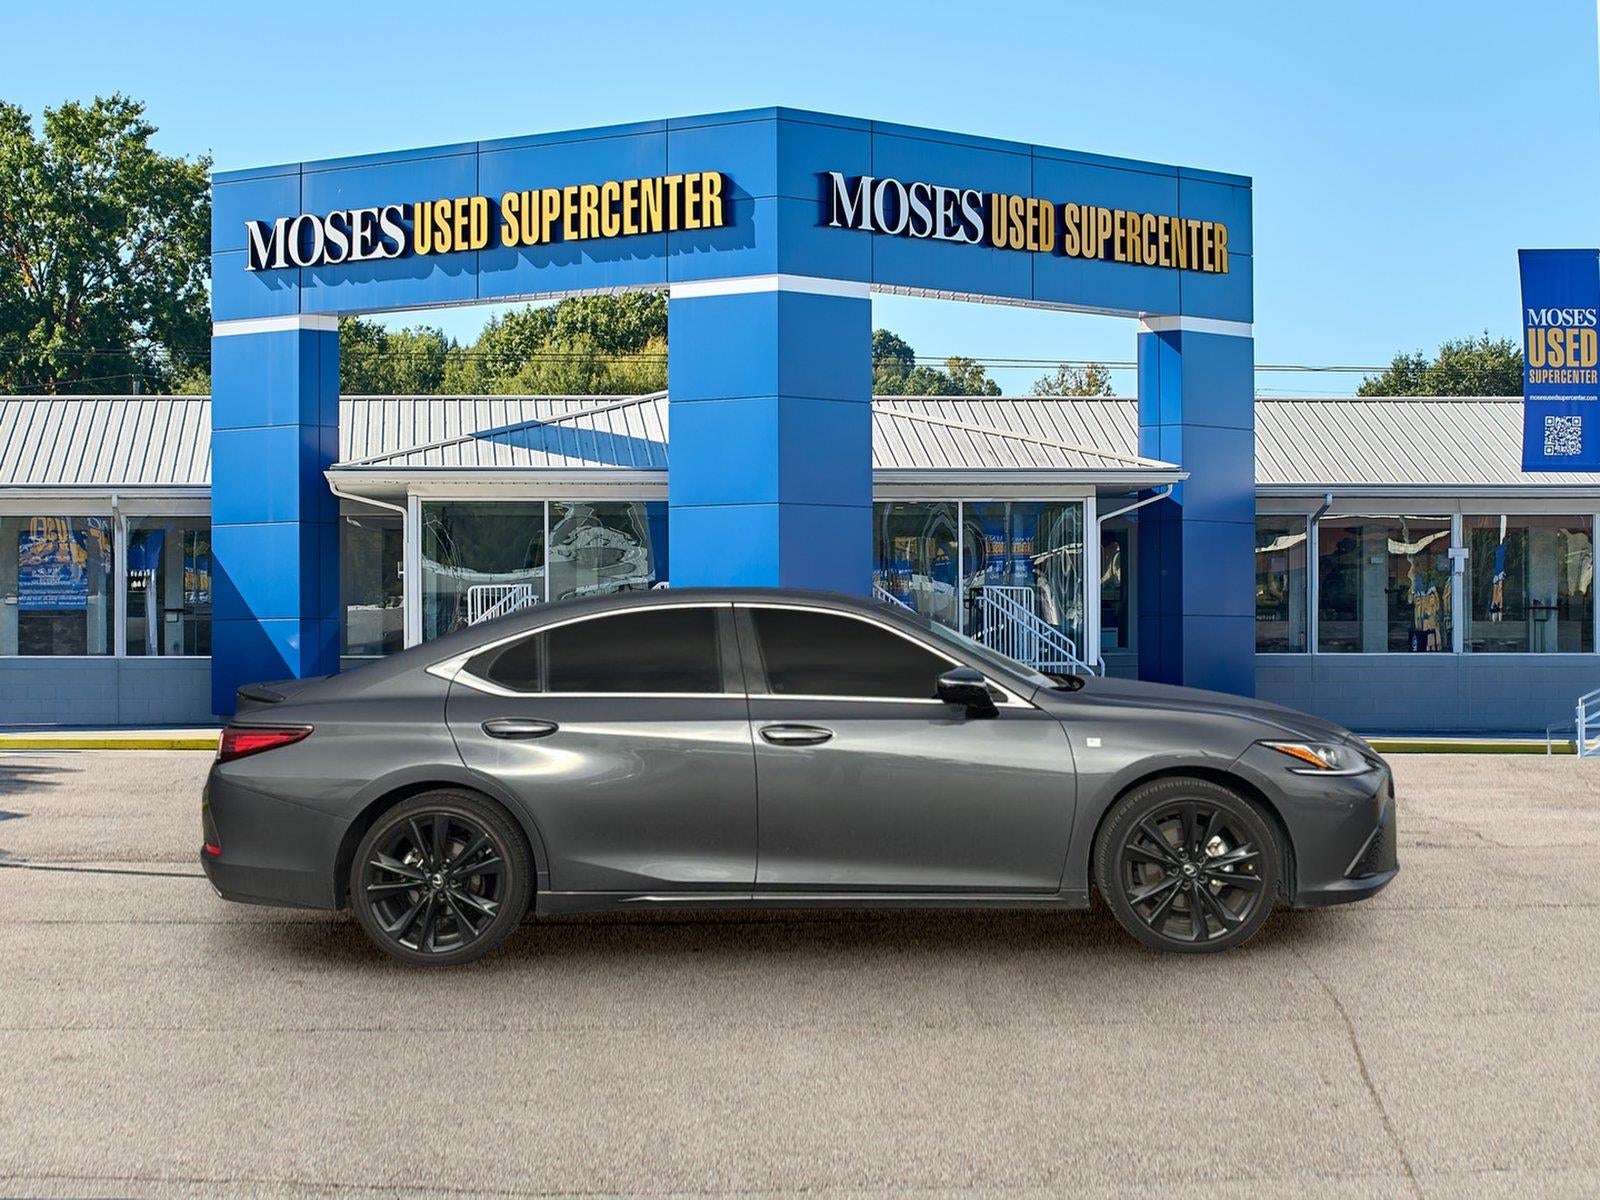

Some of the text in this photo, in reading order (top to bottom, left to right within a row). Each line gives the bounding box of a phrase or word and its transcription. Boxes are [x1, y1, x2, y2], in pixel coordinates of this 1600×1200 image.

[245, 171, 724, 271] MOSES USED SUPERCENTER
[828, 171, 1229, 274] MOSES USED SUPERCENTER
[1527, 308, 1597, 327] MOSES
[1528, 328, 1598, 368] USED
[1529, 369, 1598, 384] SUPERCENTER
